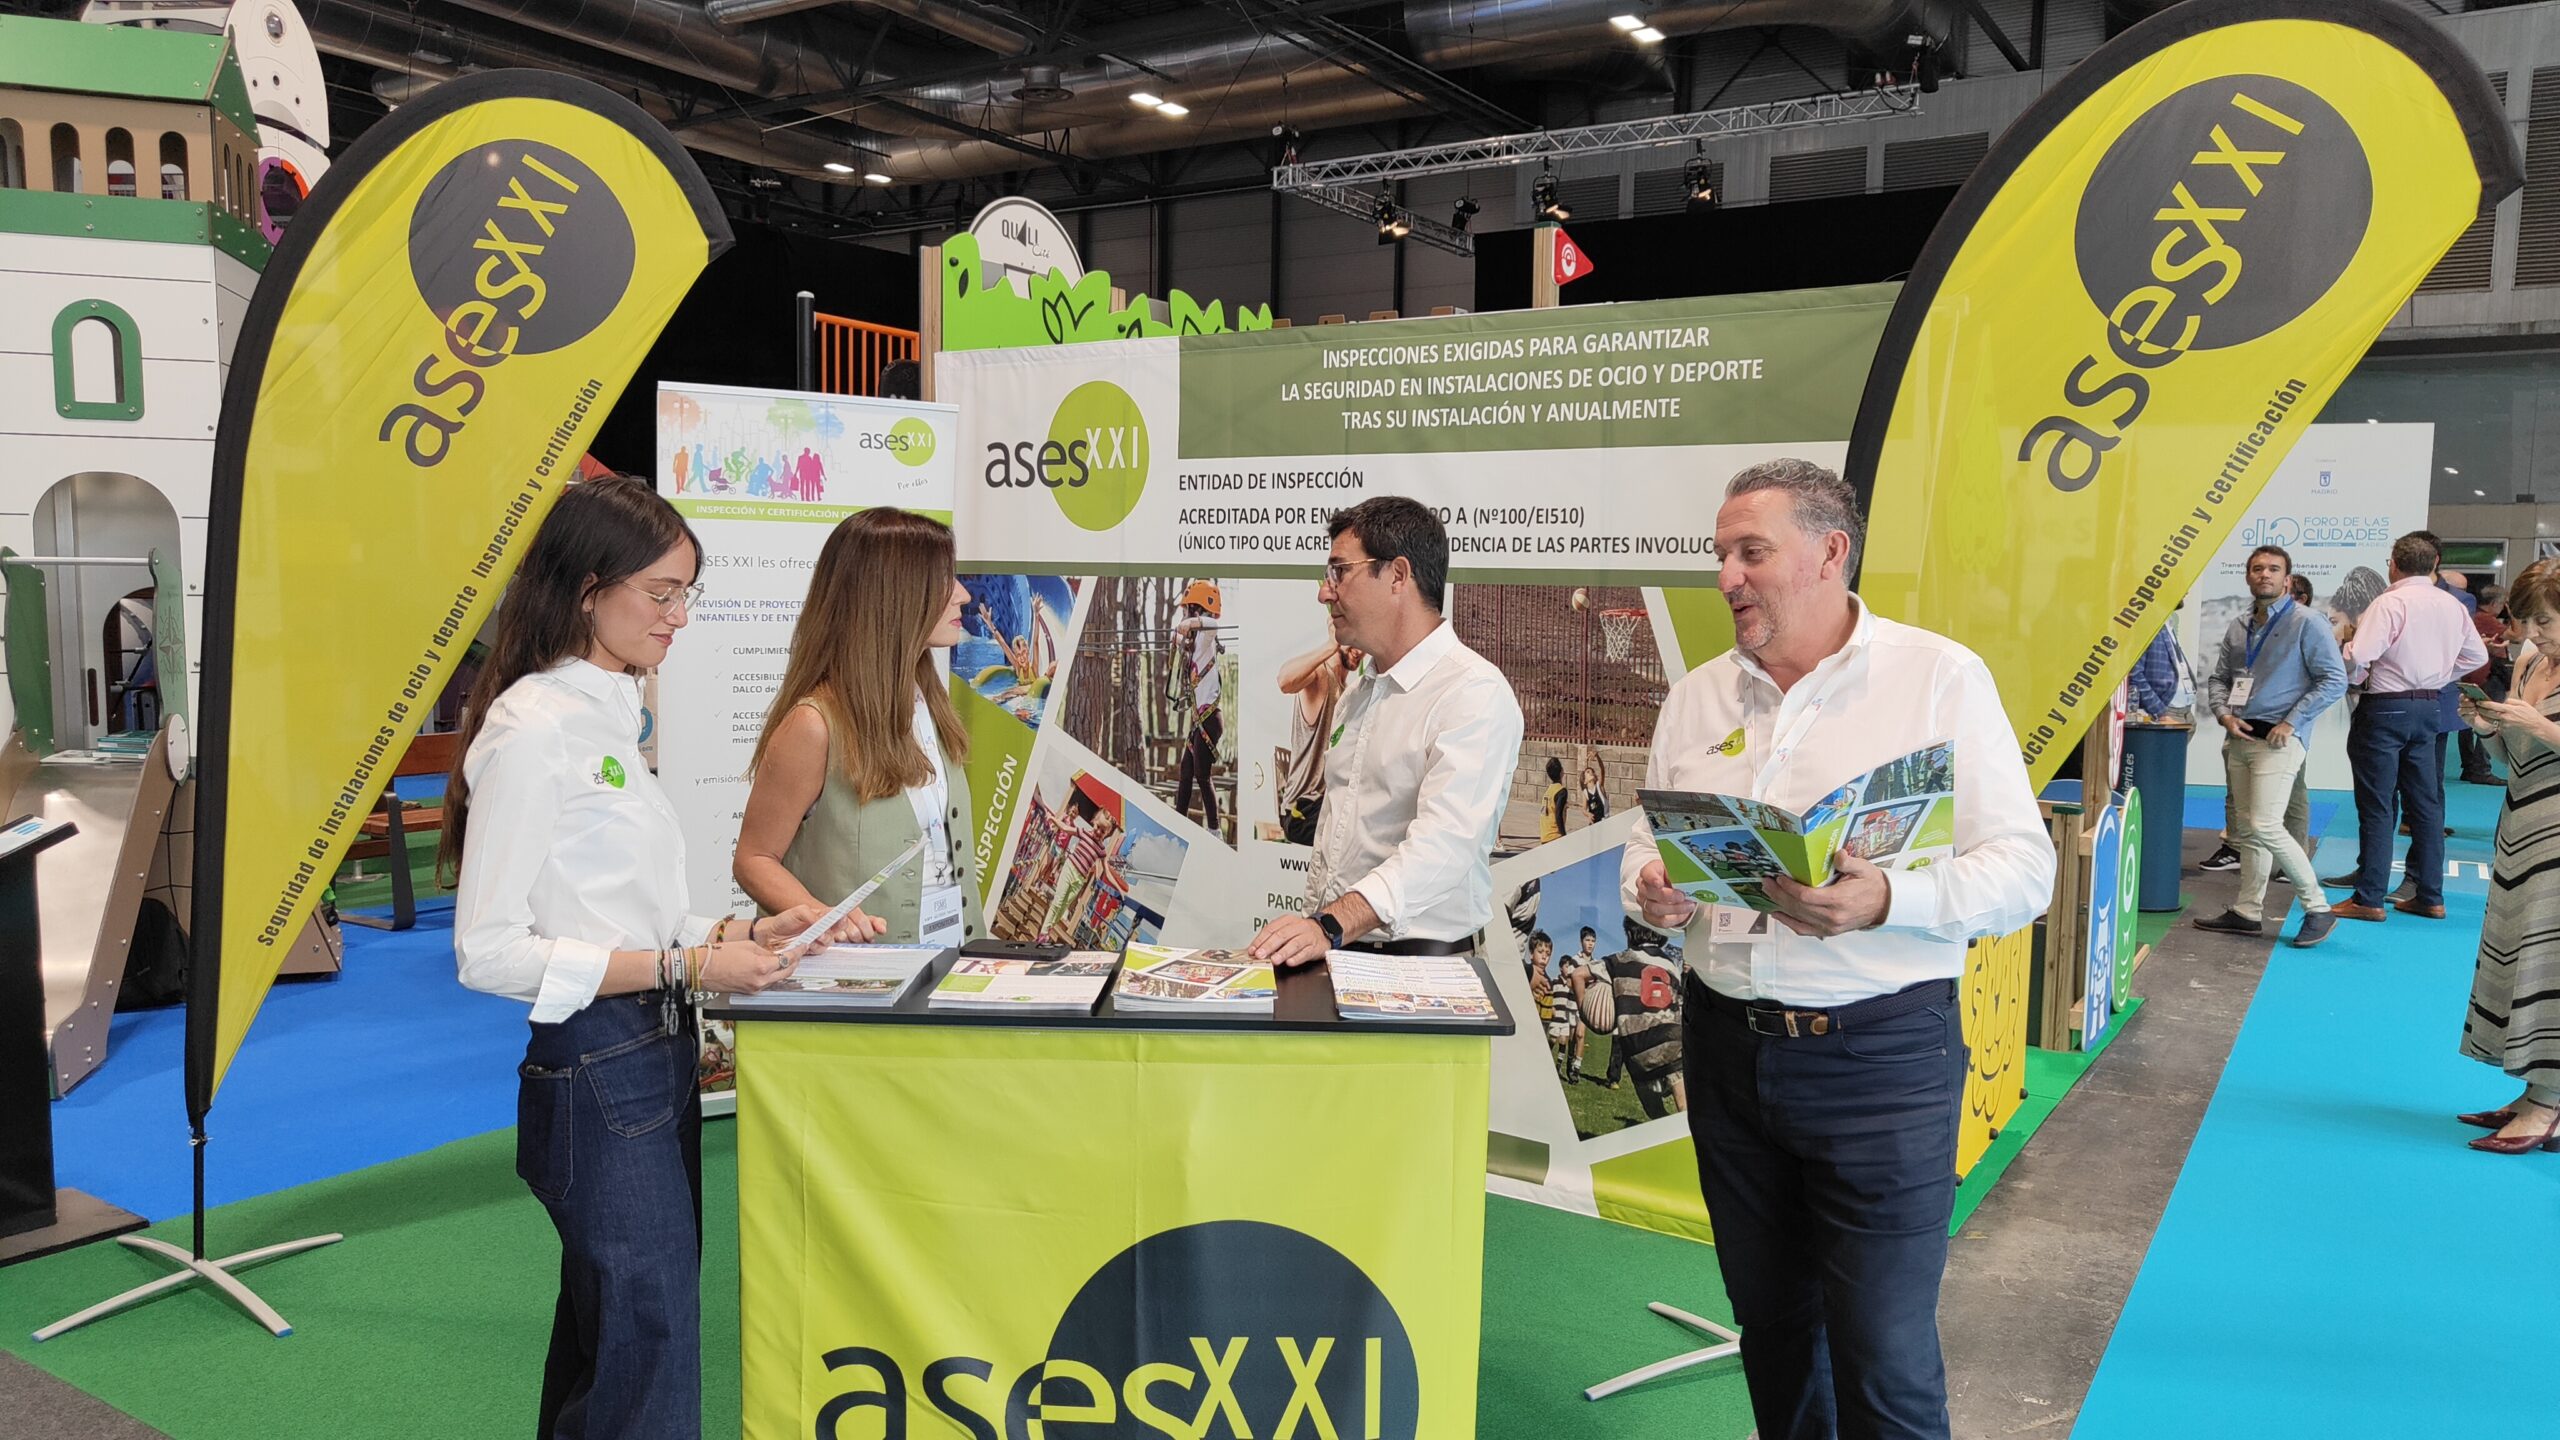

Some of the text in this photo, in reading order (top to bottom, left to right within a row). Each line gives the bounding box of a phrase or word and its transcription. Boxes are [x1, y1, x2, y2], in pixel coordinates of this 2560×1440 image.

[1323, 327, 1710, 368] INSPECCIONES EXIGIDAS PARA GARANTIZAR
[1281, 359, 1763, 401] LA SEGURIDAD EN INSTALACIONES DE OCIO Y DEPORTE
[1342, 398, 1681, 430] TRAS SU INSTALACIÓN Y ANUALMENTE
[1179, 466, 1363, 490] ENTIDAD DE INSPECCIÓN
[696, 504, 757, 515] INSPECCIÓN
[758, 507, 765, 515] Y
[767, 508, 839, 518] CERTIFICACIÓN
[1178, 508, 1270, 524] ACREDITADA
[1275, 507, 1306, 524] POR
[1456, 506, 1467, 524] A
[2304, 516, 2390, 527] FORO DE LAS
[2303, 528, 2389, 541] CIUDADES
[1178, 531, 1714, 554] (ÚNICO TIPO QUE ACRE DENCIA DE LAS PARTES INVOLUC
[704, 555, 729, 567] SES
[733, 556, 754, 567] XXI
[758, 556, 776, 568] les
[2022, 377, 2308, 767] ocio y deporte Inspección y certificación
[695, 598, 741, 608] REVISIÓN
[744, 600, 756, 608] DE
[695, 613, 750, 622] INFANTILES
[752, 613, 759, 621] Y
[732, 647, 790, 655] CUMPLIMIEN
[257, 377, 603, 946] Seguridad de instalaciones de ocio y deporte Inspección y certificación
[732, 673, 785, 681] ACCESIBILID
[732, 685, 779, 693] DALCO del
[732, 724, 762, 732] DALCO
[732, 736, 758, 744] mient
[703, 774, 740, 785] emisión
[975, 753, 1018, 883] INSPECCIÓN
[731, 900, 755, 908] juego
[1640, 965, 1674, 1008] 6
